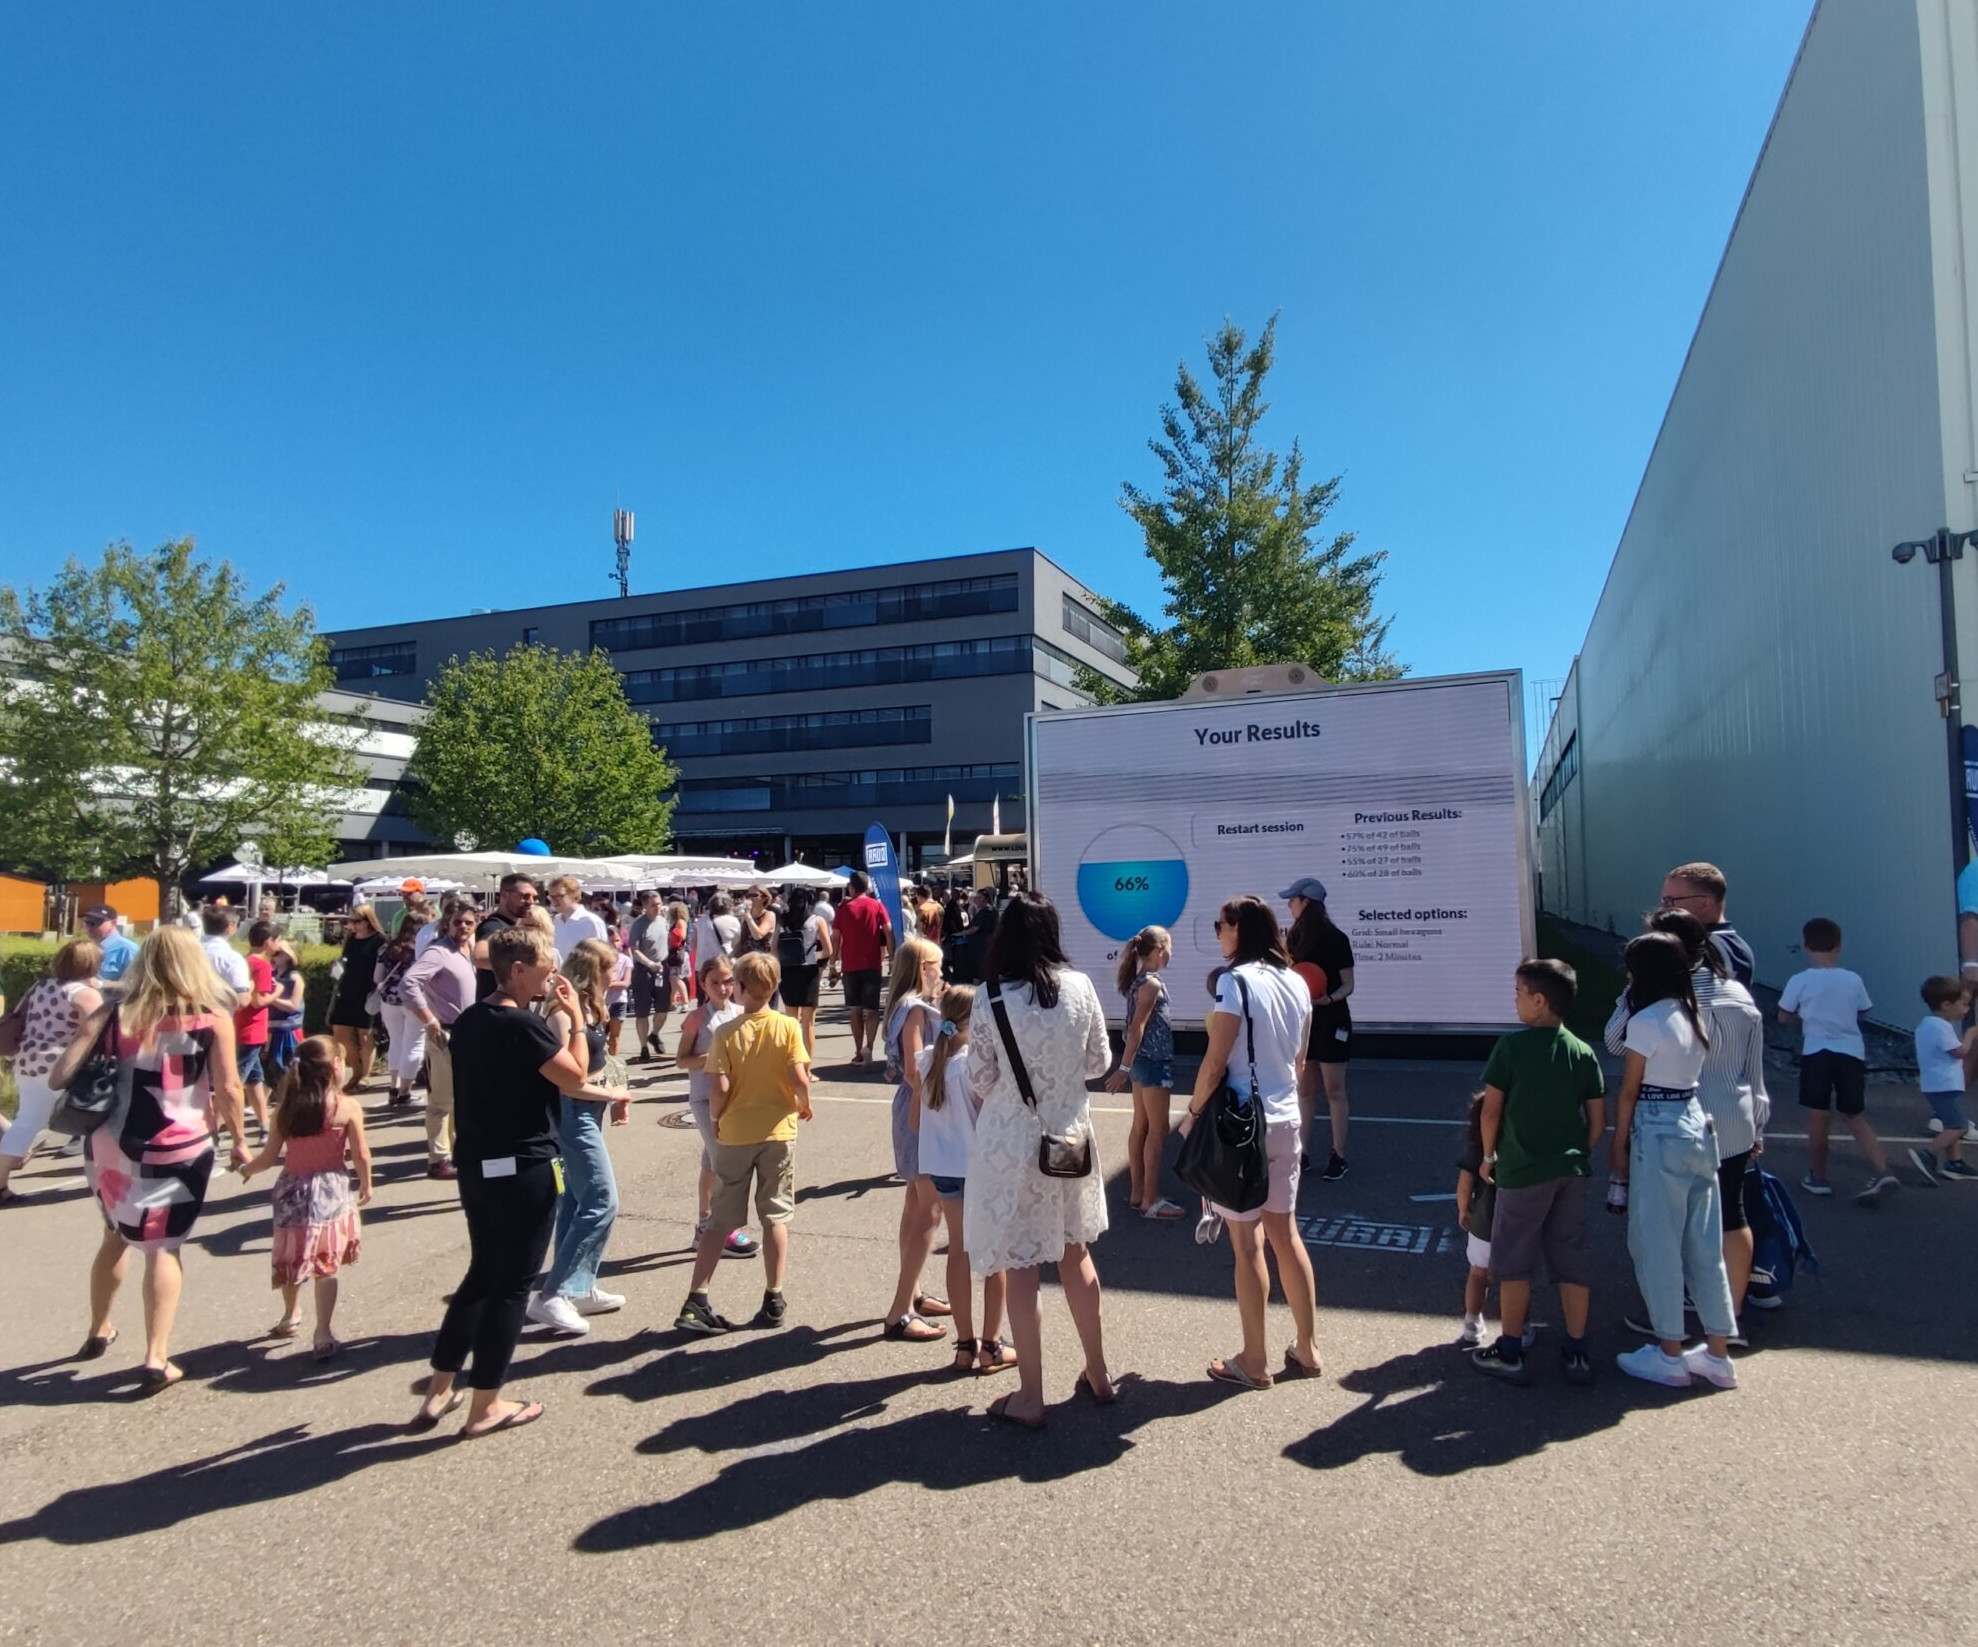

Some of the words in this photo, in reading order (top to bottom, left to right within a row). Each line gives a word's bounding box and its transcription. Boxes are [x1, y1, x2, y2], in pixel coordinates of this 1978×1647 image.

[1194, 727, 1242, 746] Your
[1246, 720, 1321, 742] Results
[1354, 812, 1409, 824] Previous
[1411, 808, 1462, 821] Results:
[1217, 823, 1259, 835] Restart
[1261, 822, 1304, 833] session
[1400, 829, 1420, 838] balls
[1400, 842, 1420, 850] balls
[1367, 857, 1376, 865] of
[1390, 856, 1399, 864] of
[1401, 855, 1421, 863] balls
[1401, 868, 1422, 876] balls
[1114, 876, 1150, 891] 66%
[1358, 909, 1411, 920] Selected
[1414, 908, 1467, 921] options:
[1375, 928, 1398, 936] Small
[1400, 928, 1442, 936] hexagons
[1376, 940, 1408, 948] Normal
[1378, 953, 1383, 961] 2
[1386, 953, 1422, 961] Minutes
